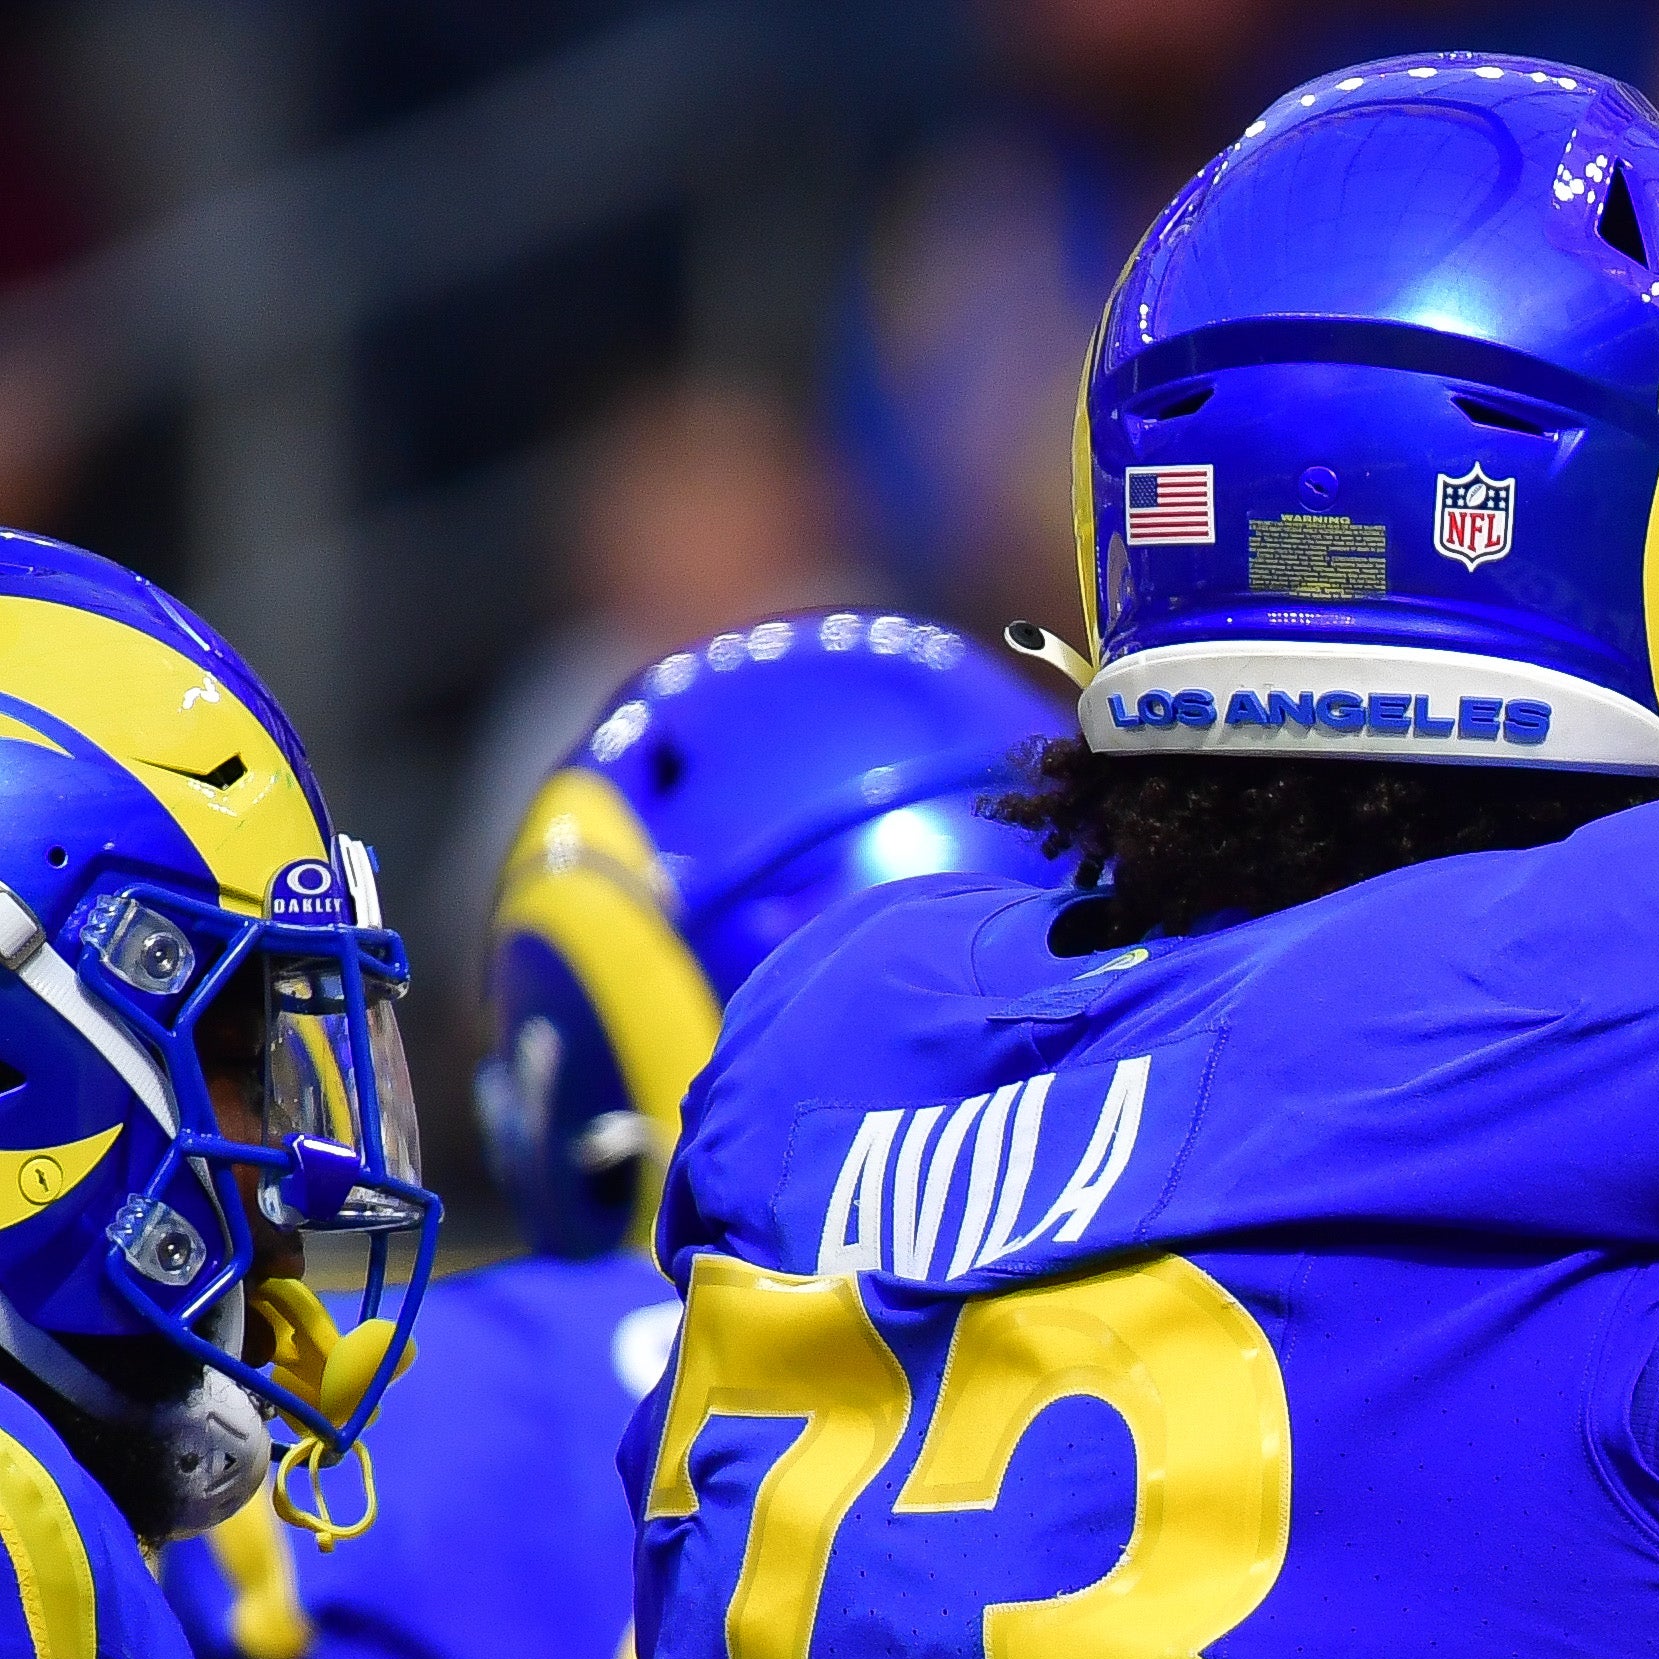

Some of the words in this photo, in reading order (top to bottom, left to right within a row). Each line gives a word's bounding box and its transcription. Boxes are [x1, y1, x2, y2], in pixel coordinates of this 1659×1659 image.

[1281, 513, 1350, 524] WARNING
[1446, 511, 1501, 553] NFL
[1107, 688, 1217, 729] LOS
[1224, 689, 1552, 746] ANGELES
[273, 897, 342, 914] OAKLEY
[816, 1054, 1152, 1281] AVILA
